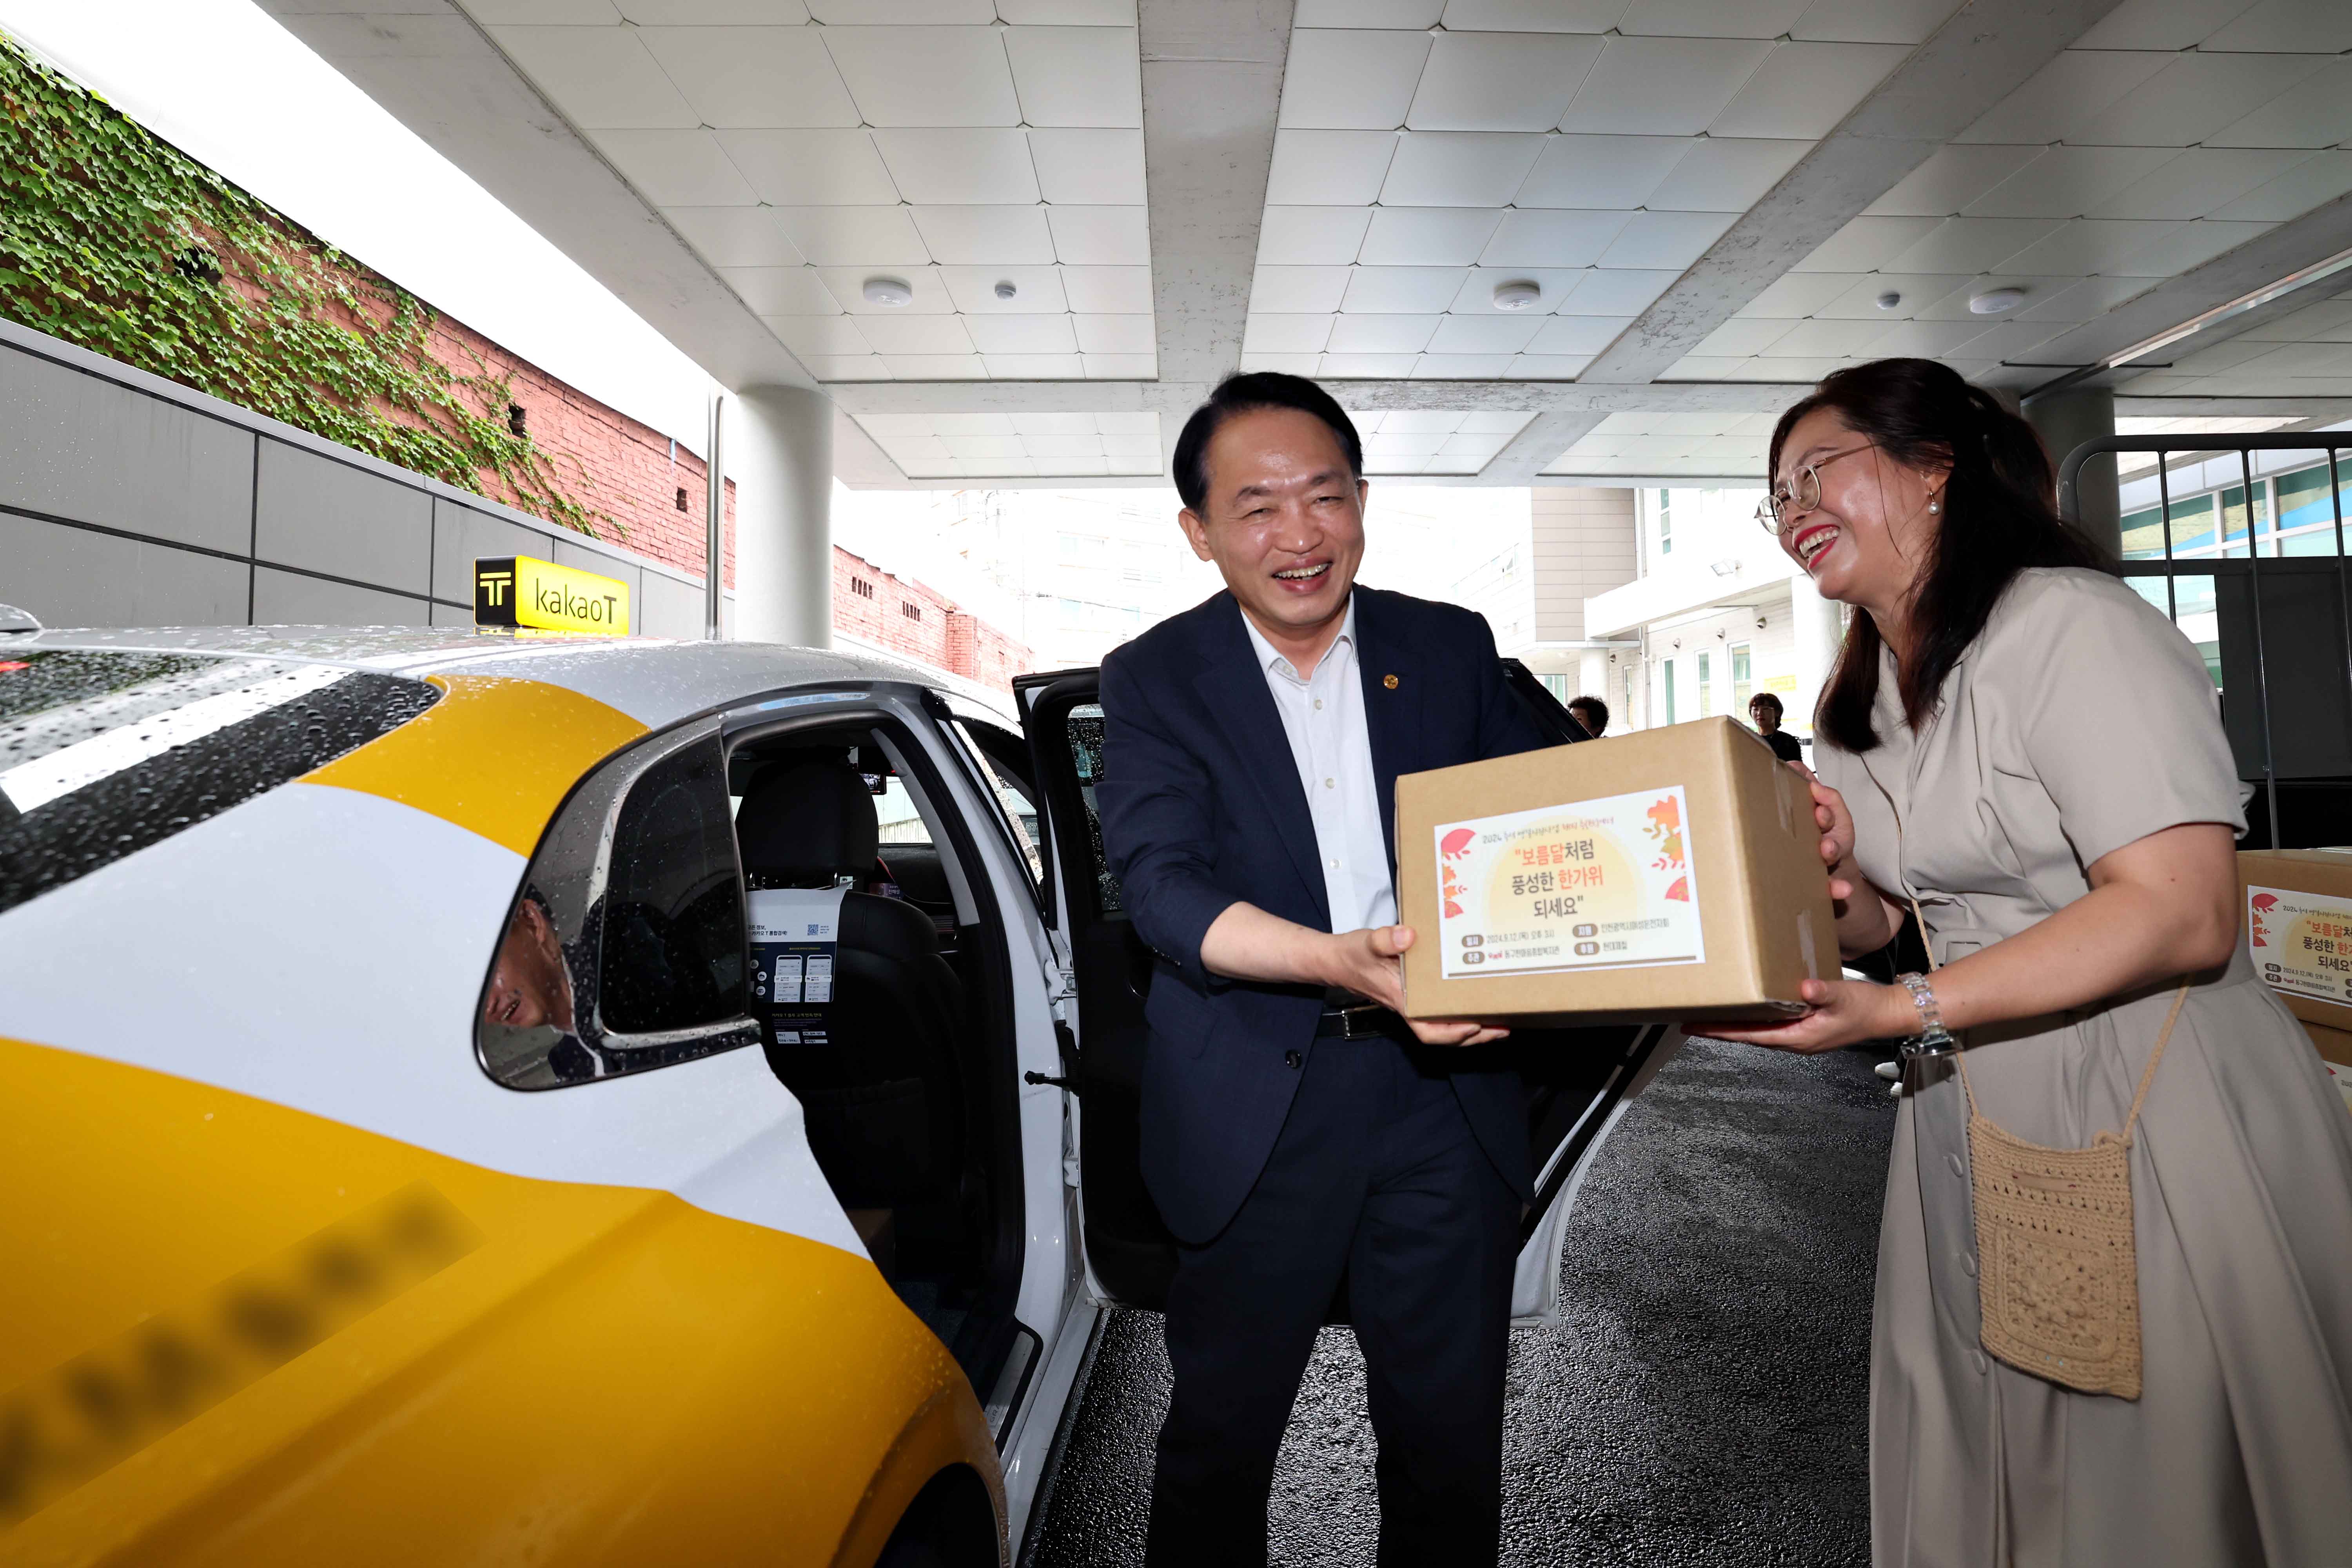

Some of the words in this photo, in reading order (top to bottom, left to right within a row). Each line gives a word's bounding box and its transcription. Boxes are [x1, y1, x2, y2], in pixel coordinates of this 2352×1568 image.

[1515, 838, 1595, 866] "보름달처럼
[1512, 871, 1554, 895] 풍성한
[1558, 865, 1603, 890] 한가위
[1534, 895, 1583, 919] 되세요"
[2303, 936, 2335, 953] 풍성한
